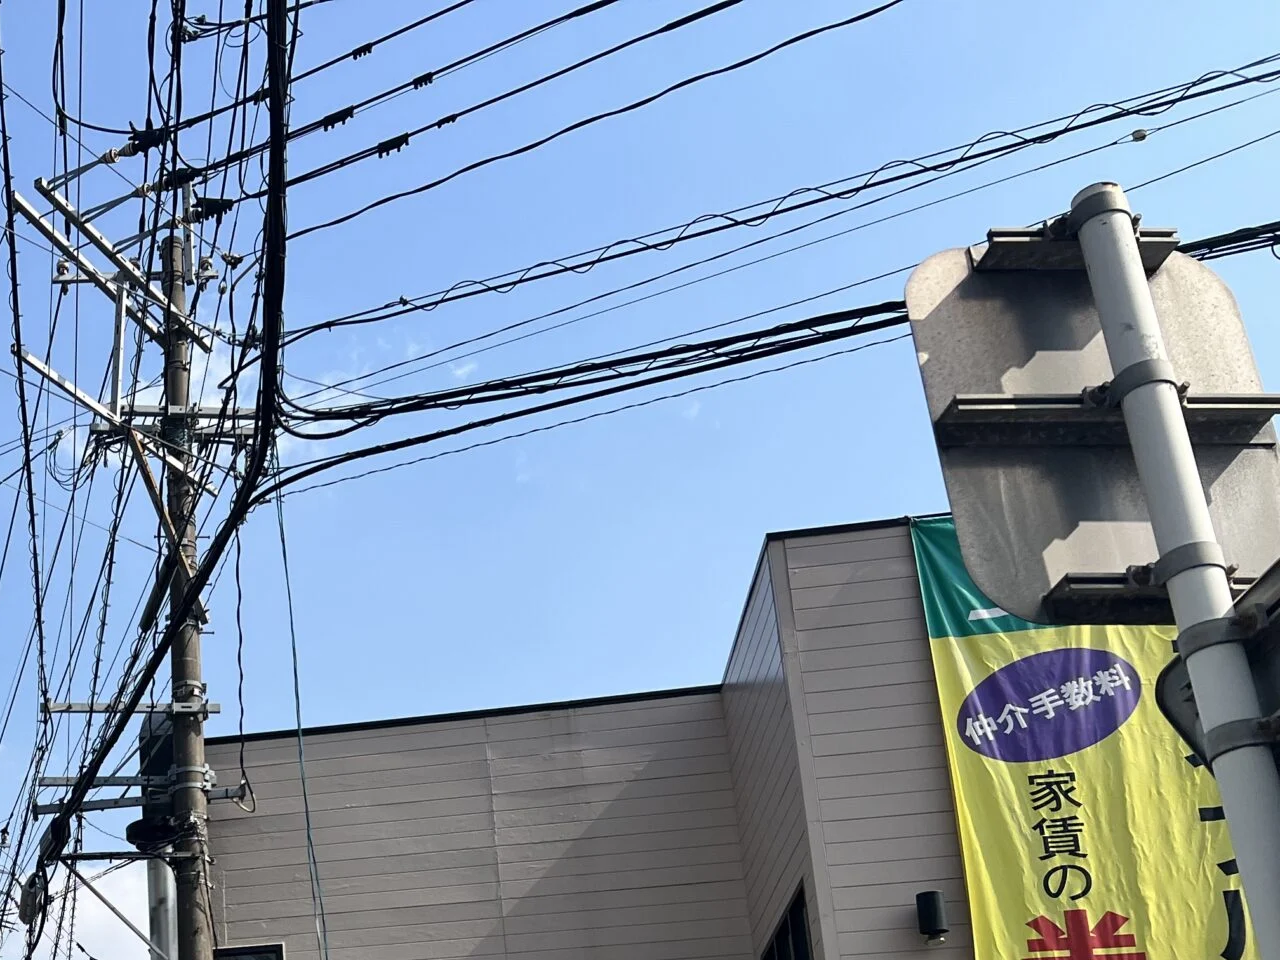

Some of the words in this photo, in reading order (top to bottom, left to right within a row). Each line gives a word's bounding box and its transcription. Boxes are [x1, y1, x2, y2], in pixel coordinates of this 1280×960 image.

[964, 663, 1133, 747] 仲介手数料
